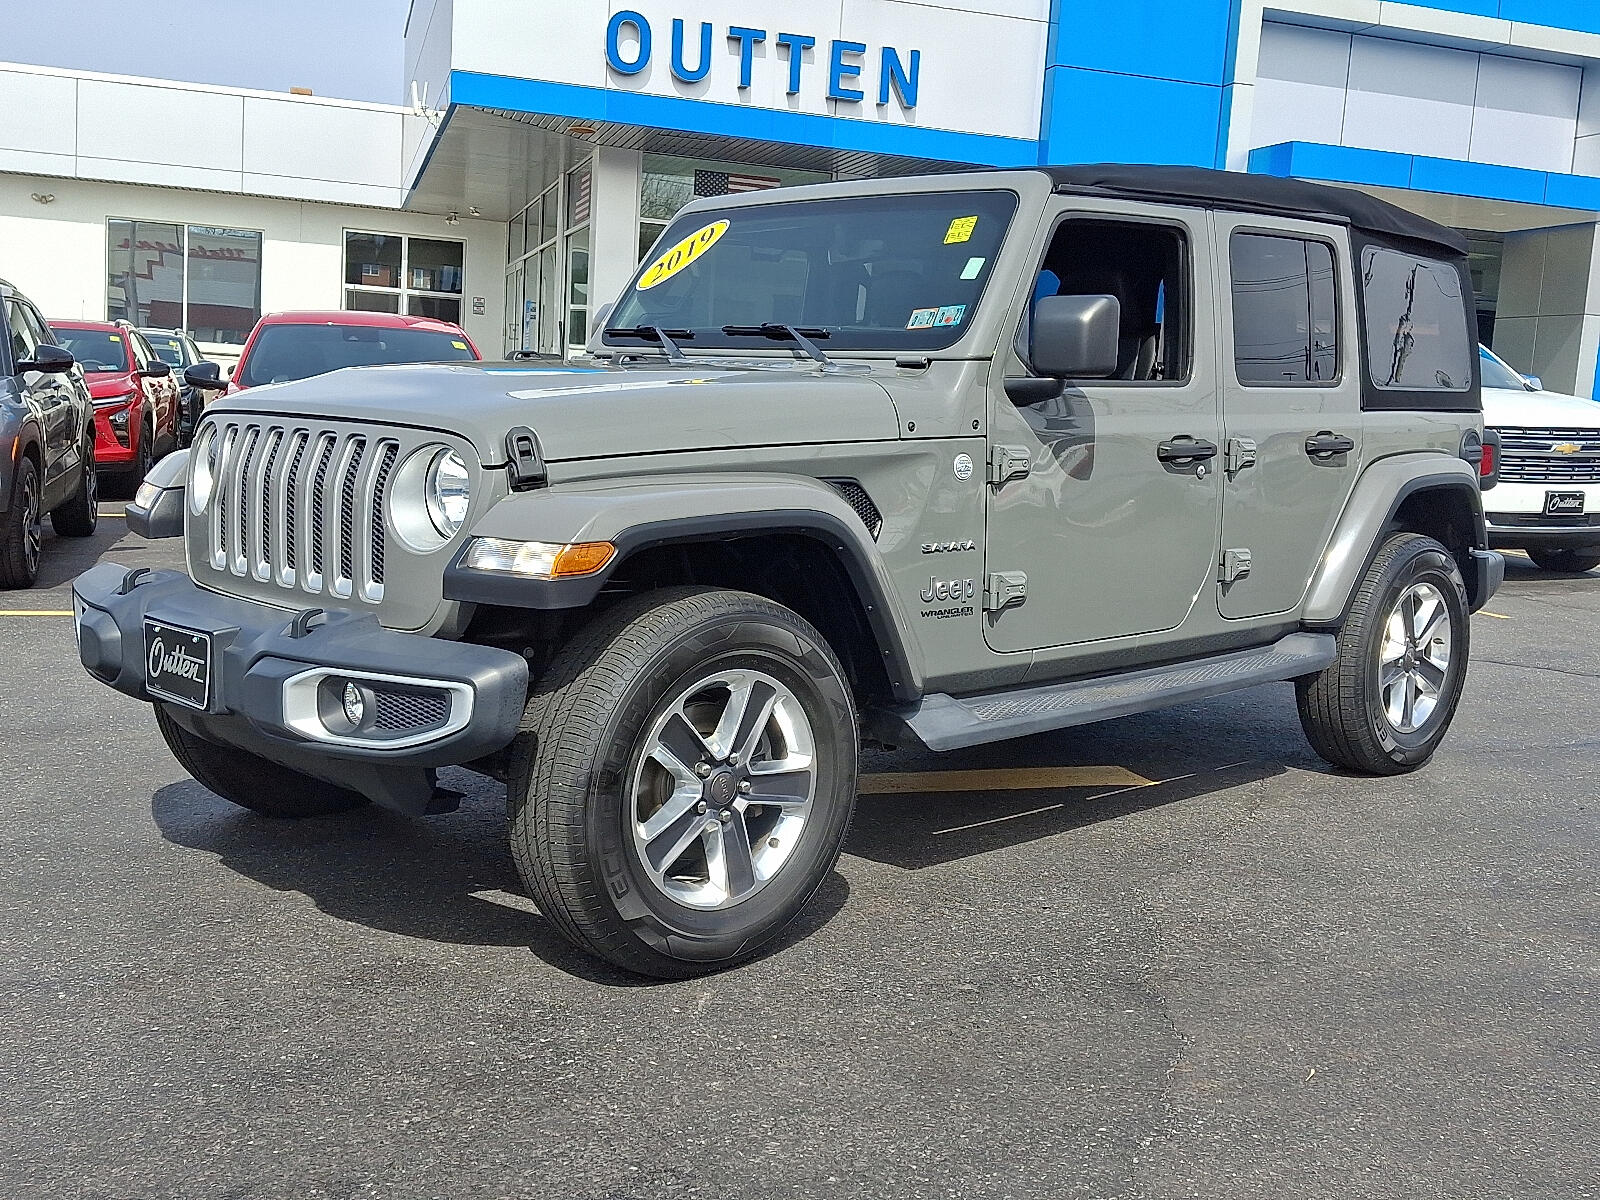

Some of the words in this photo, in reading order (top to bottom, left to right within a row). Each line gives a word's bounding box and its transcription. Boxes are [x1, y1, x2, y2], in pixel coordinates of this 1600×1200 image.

[606, 10, 920, 109] OUTTEN
[650, 227, 715, 284] 2019
[921, 540, 976, 554] SAHARA
[920, 576, 975, 603] Jeep
[920, 606, 974, 618] WRANGLER
[149, 637, 205, 684] Outten
